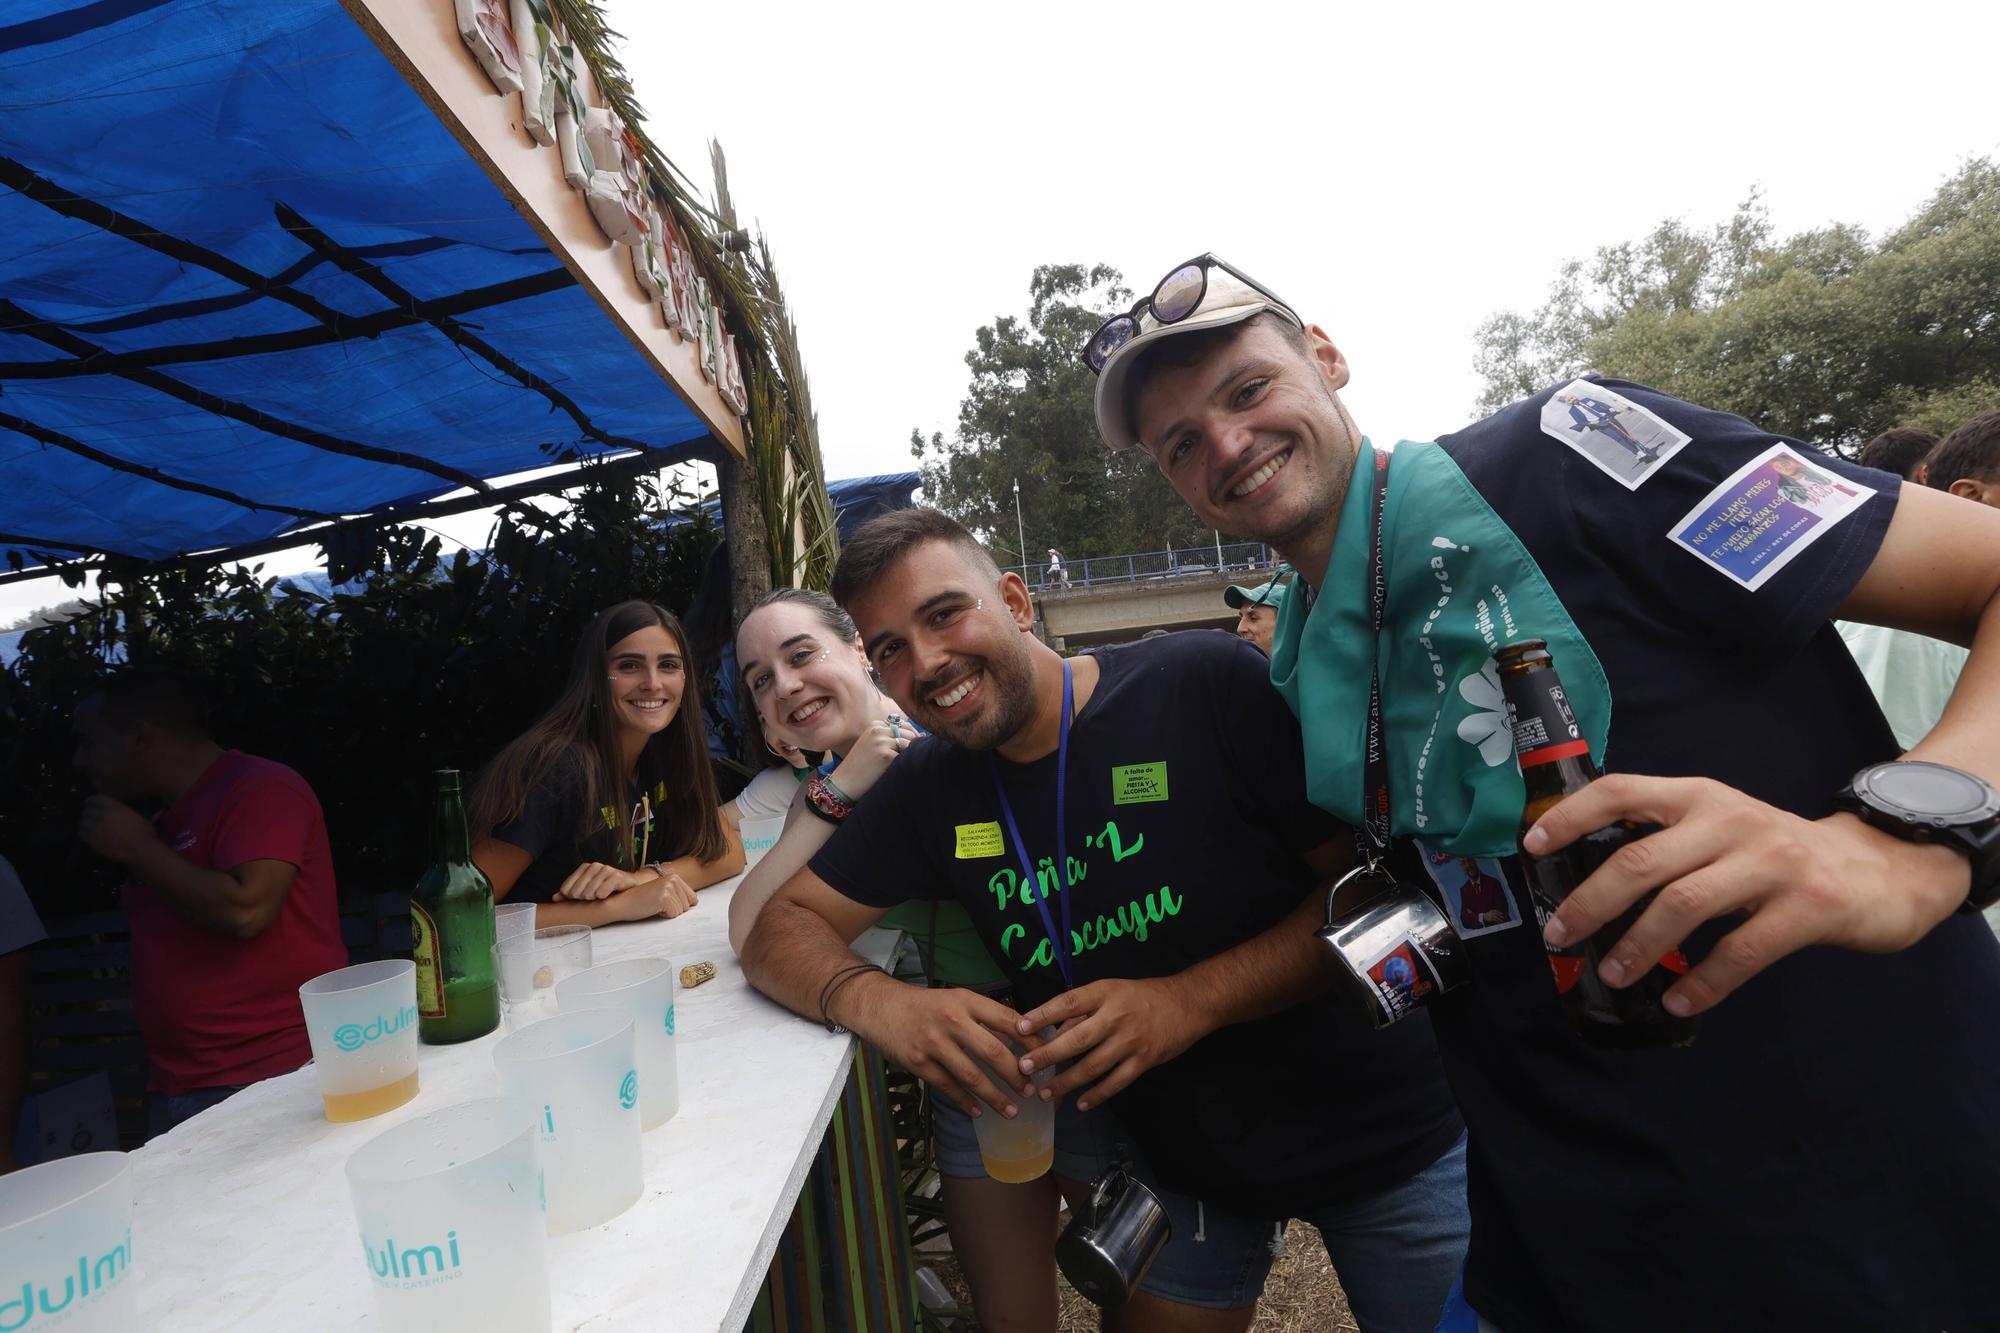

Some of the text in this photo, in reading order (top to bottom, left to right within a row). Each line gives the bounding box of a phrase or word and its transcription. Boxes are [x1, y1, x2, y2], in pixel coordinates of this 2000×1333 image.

[1692, 532, 1708, 545] NO
[1705, 520, 1721, 534] ME
[1718, 497, 1747, 522] LLAMO
[1710, 548, 1724, 559] TE
[1722, 526, 1750, 552] PUEDO
[1748, 506, 1773, 526] SACAR
[1728, 506, 1752, 528] PERO
[1732, 513, 1780, 553] GARBANZOS
[1491, 584, 1508, 607] 2023
[988, 856, 1087, 911] Peña
